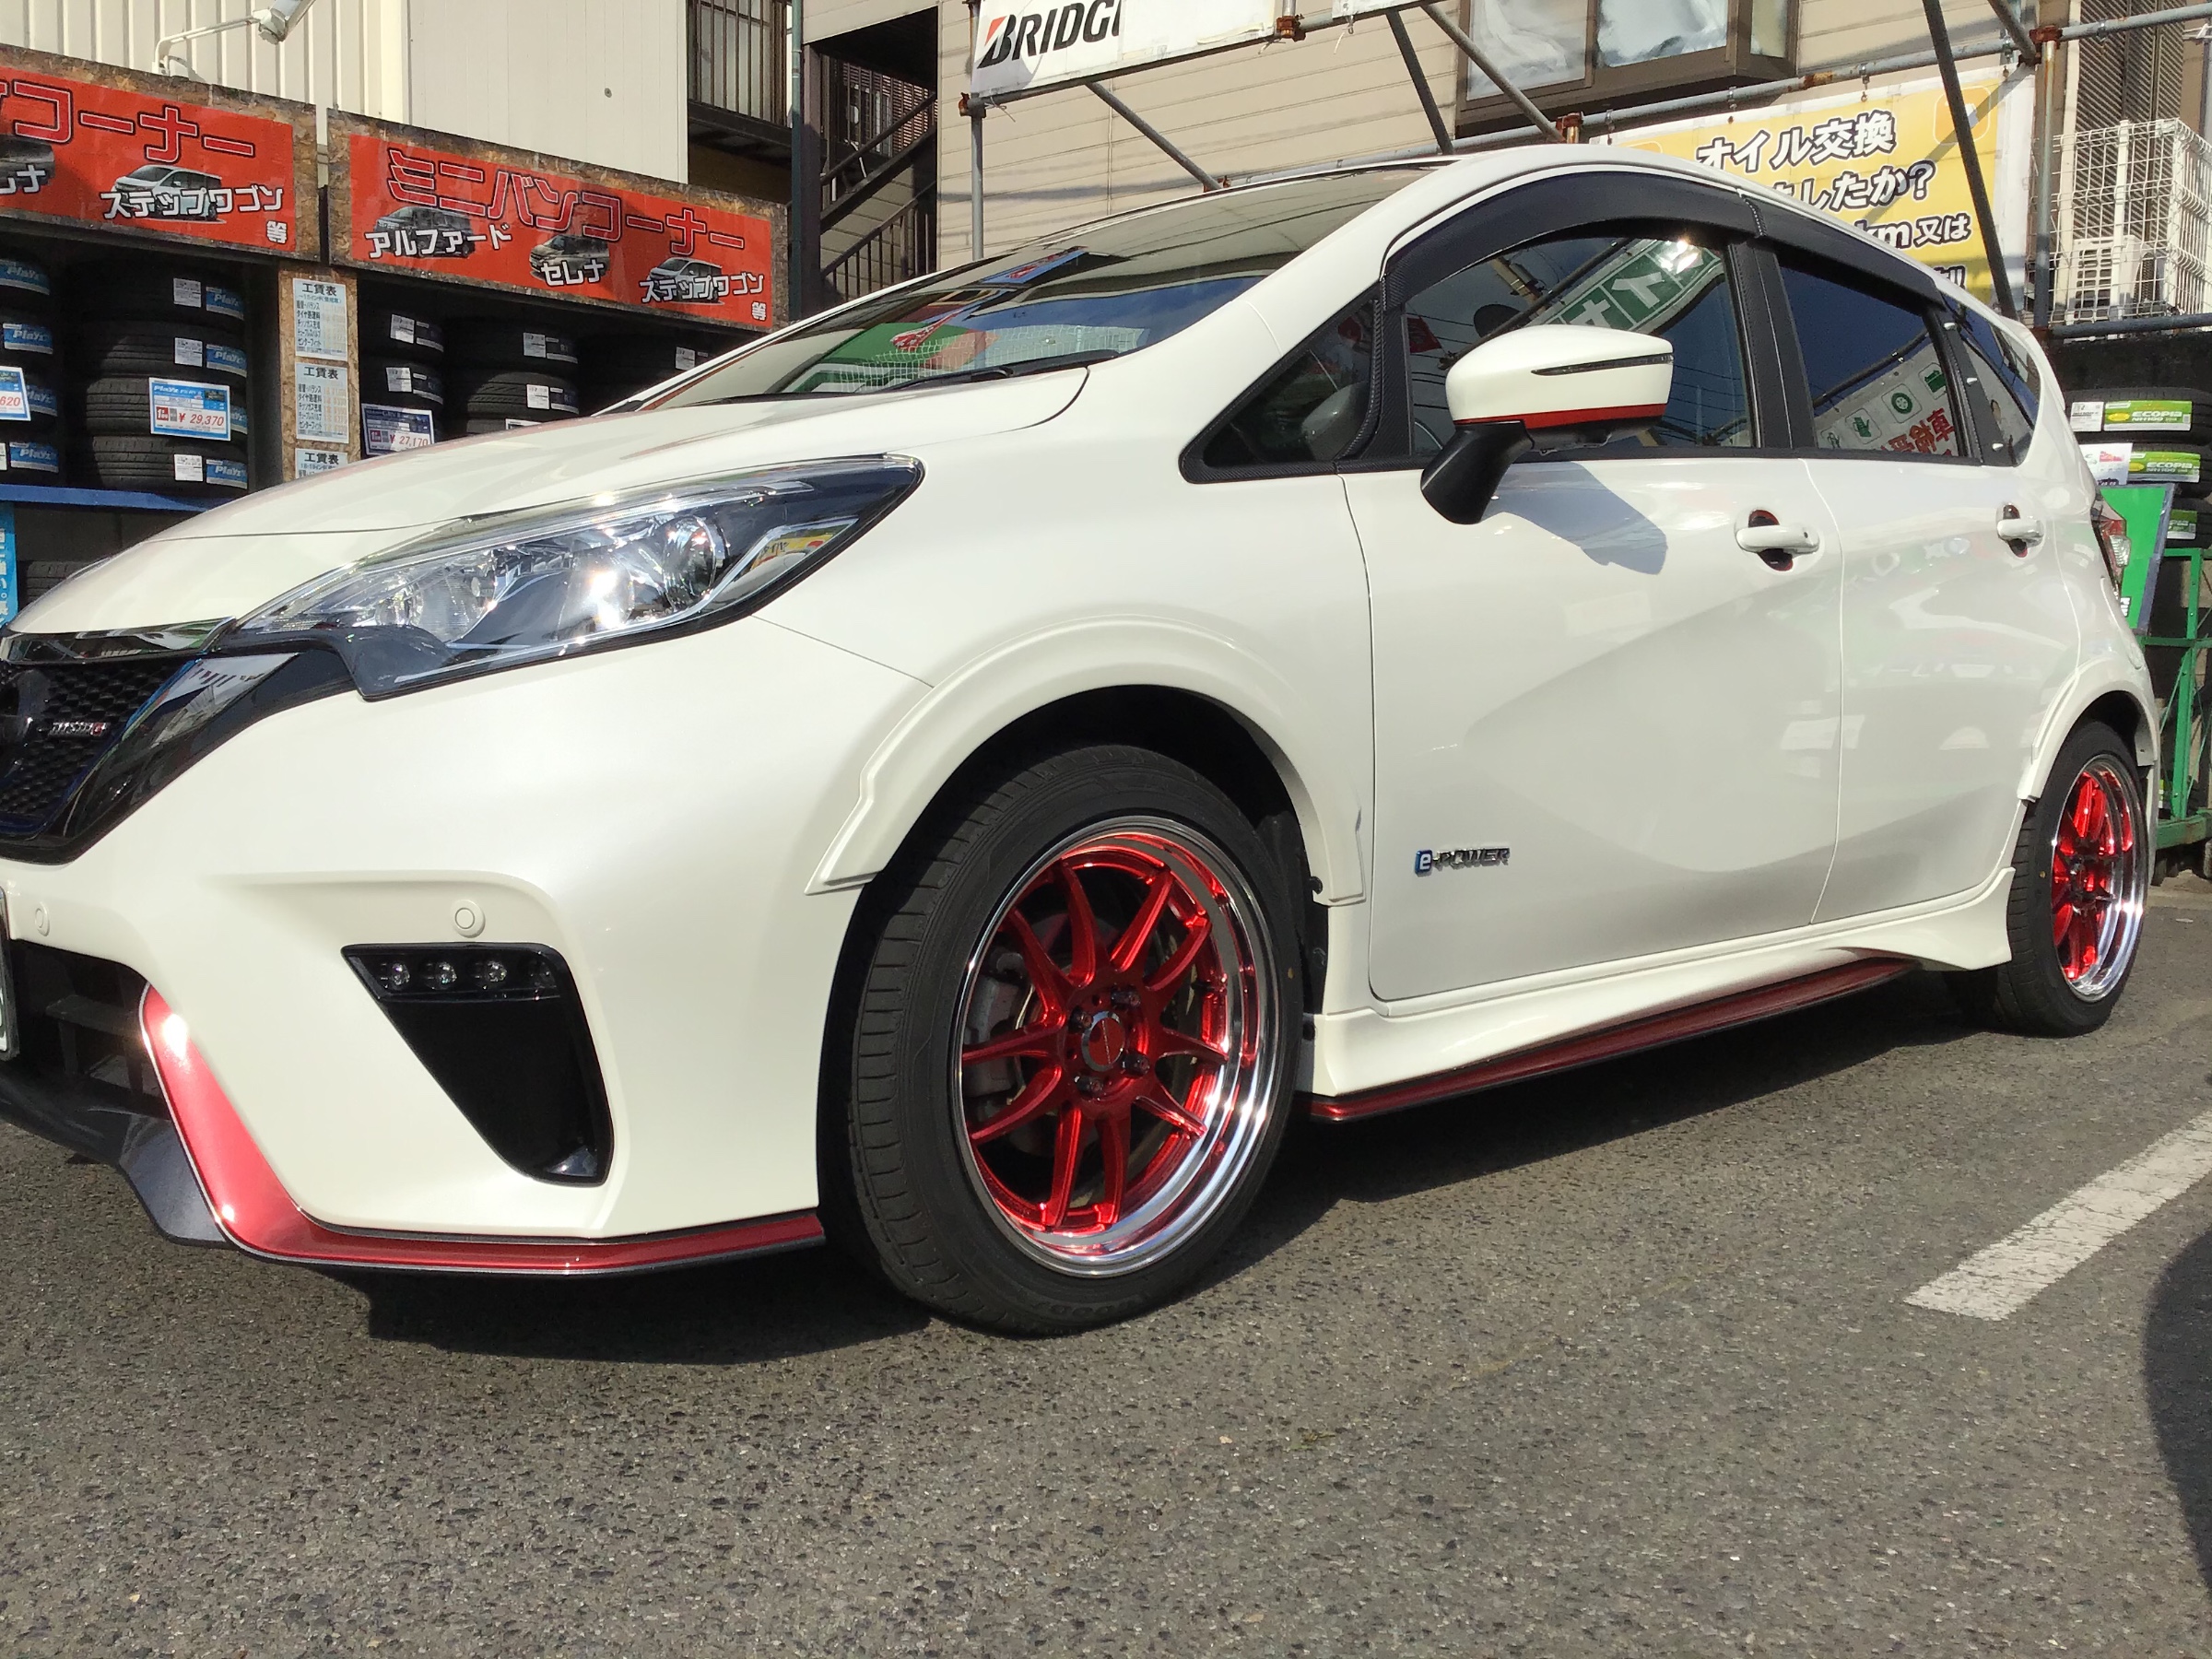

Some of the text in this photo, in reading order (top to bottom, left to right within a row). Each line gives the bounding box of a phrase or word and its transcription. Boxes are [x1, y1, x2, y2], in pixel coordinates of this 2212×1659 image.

[0, 80, 255, 163] コーナー
[1695, 109, 1897, 173] オイル交換
[100, 184, 284, 219] ステップワゴン
[387, 147, 746, 257] ミニバンコーナー
[265, 220, 288, 244] 等
[365, 224, 512, 259] アルファード
[1914, 213, 1971, 246] 又は
[540, 259, 605, 287] セレナ
[302, 282, 337, 296] 工賃表
[639, 272, 765, 303] ステップワゴン
[750, 301, 767, 321] 等
[303, 366, 339, 380] 工賃表
[189, 413, 225, 427] 29,370
[398, 435, 429, 448] 27,170
[304, 452, 339, 465] 工賃表
